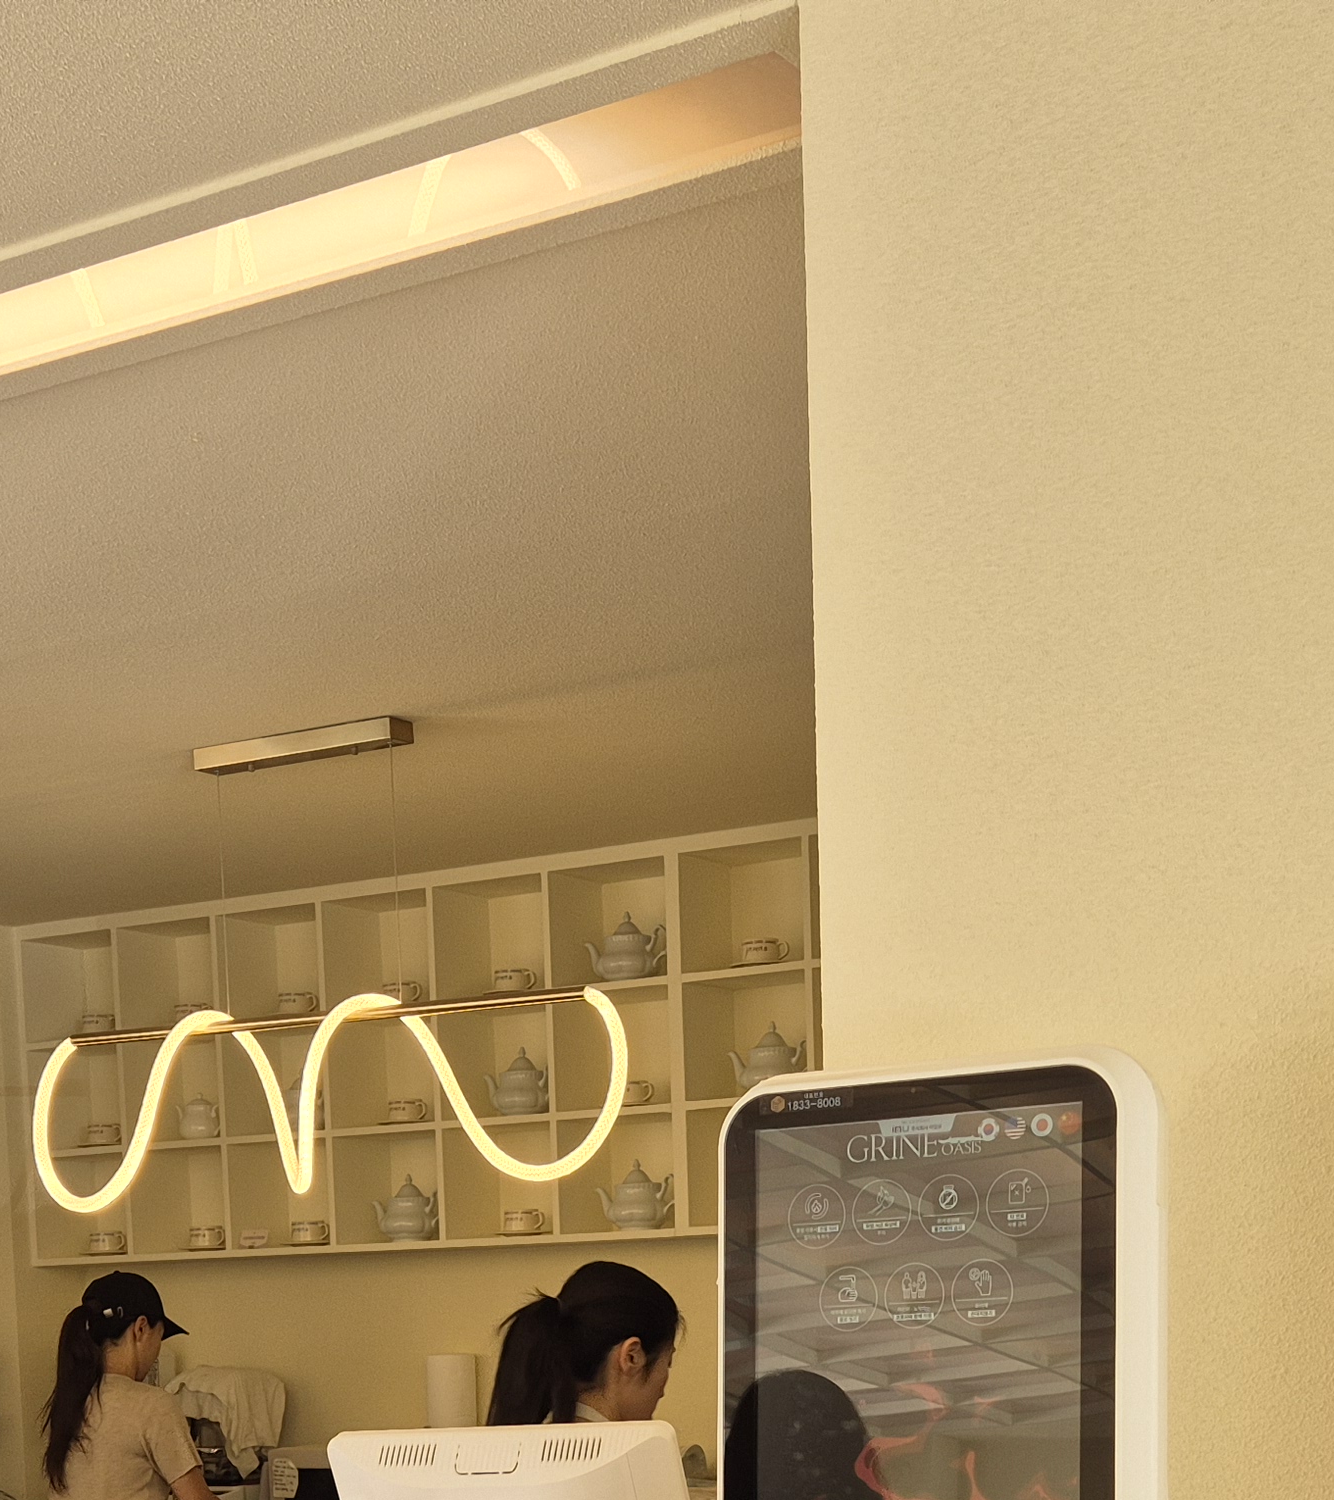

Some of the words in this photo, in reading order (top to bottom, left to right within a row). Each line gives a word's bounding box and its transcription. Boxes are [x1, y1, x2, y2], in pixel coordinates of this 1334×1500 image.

[788, 1096, 841, 1111] 1833-8008
[847, 1133, 938, 1163] GRINE
[941, 1140, 982, 1156] OASIS
